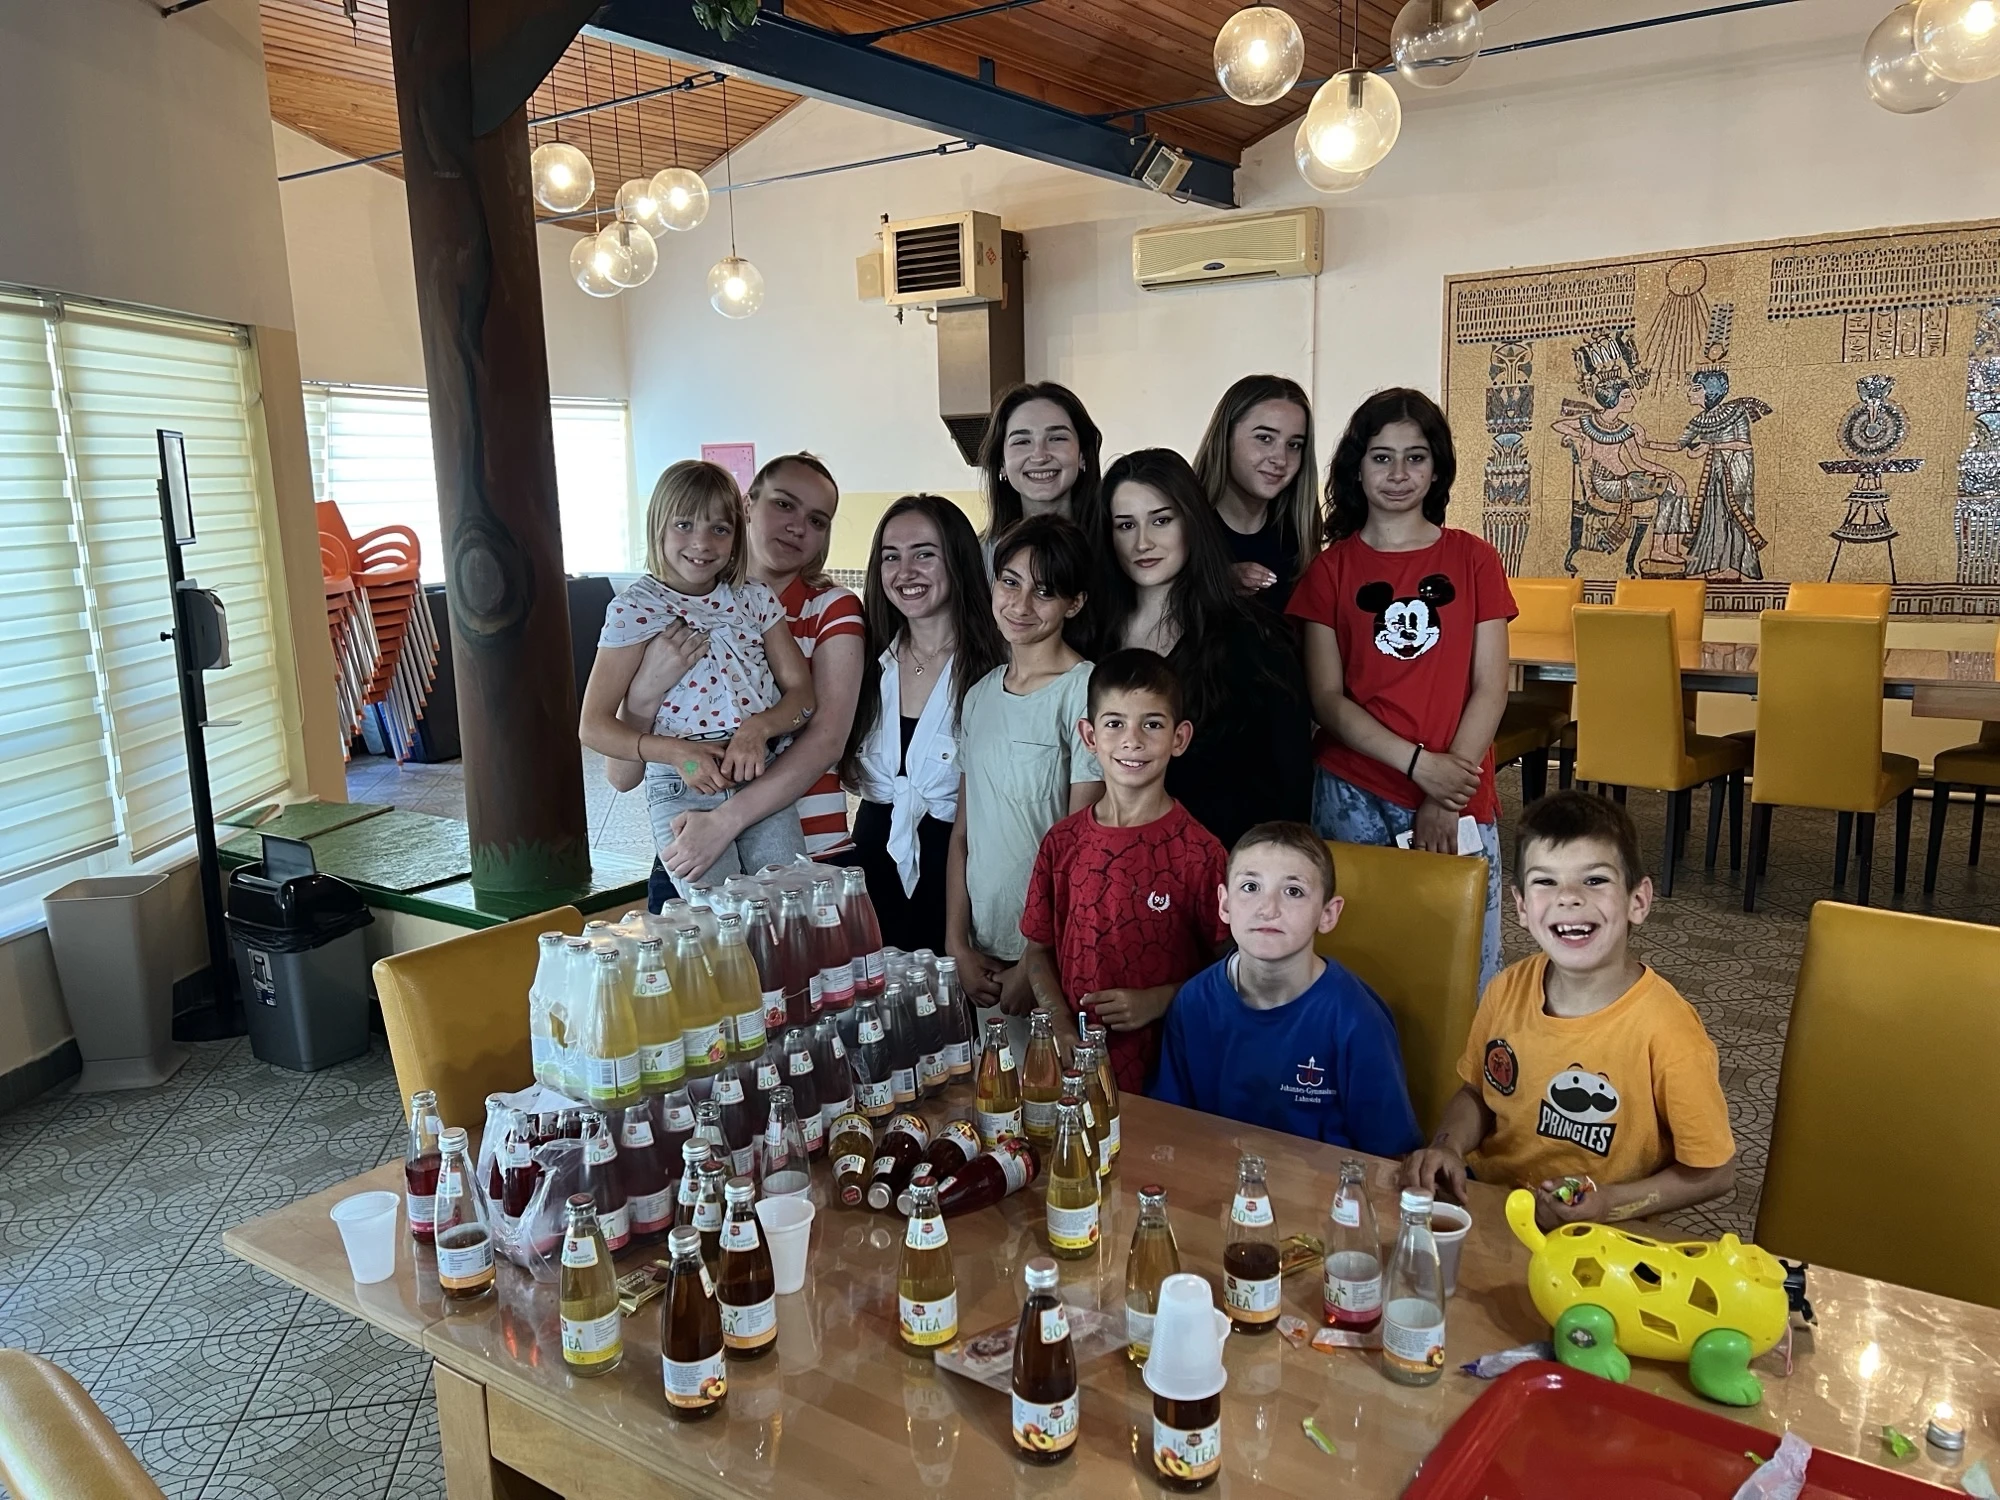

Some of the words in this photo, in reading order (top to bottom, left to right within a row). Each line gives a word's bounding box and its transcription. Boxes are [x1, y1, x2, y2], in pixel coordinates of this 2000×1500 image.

[868, 1094, 886, 1106] TEA
[1539, 1105, 1611, 1153] PRINGLES
[1230, 1291, 1250, 1310] TEA
[918, 1317, 941, 1332] TEA
[563, 1334, 582, 1351] TEA
[1036, 1413, 1055, 1432] ICE
[1055, 1417, 1076, 1436] TEA
[1194, 1443, 1216, 1463] TEA
